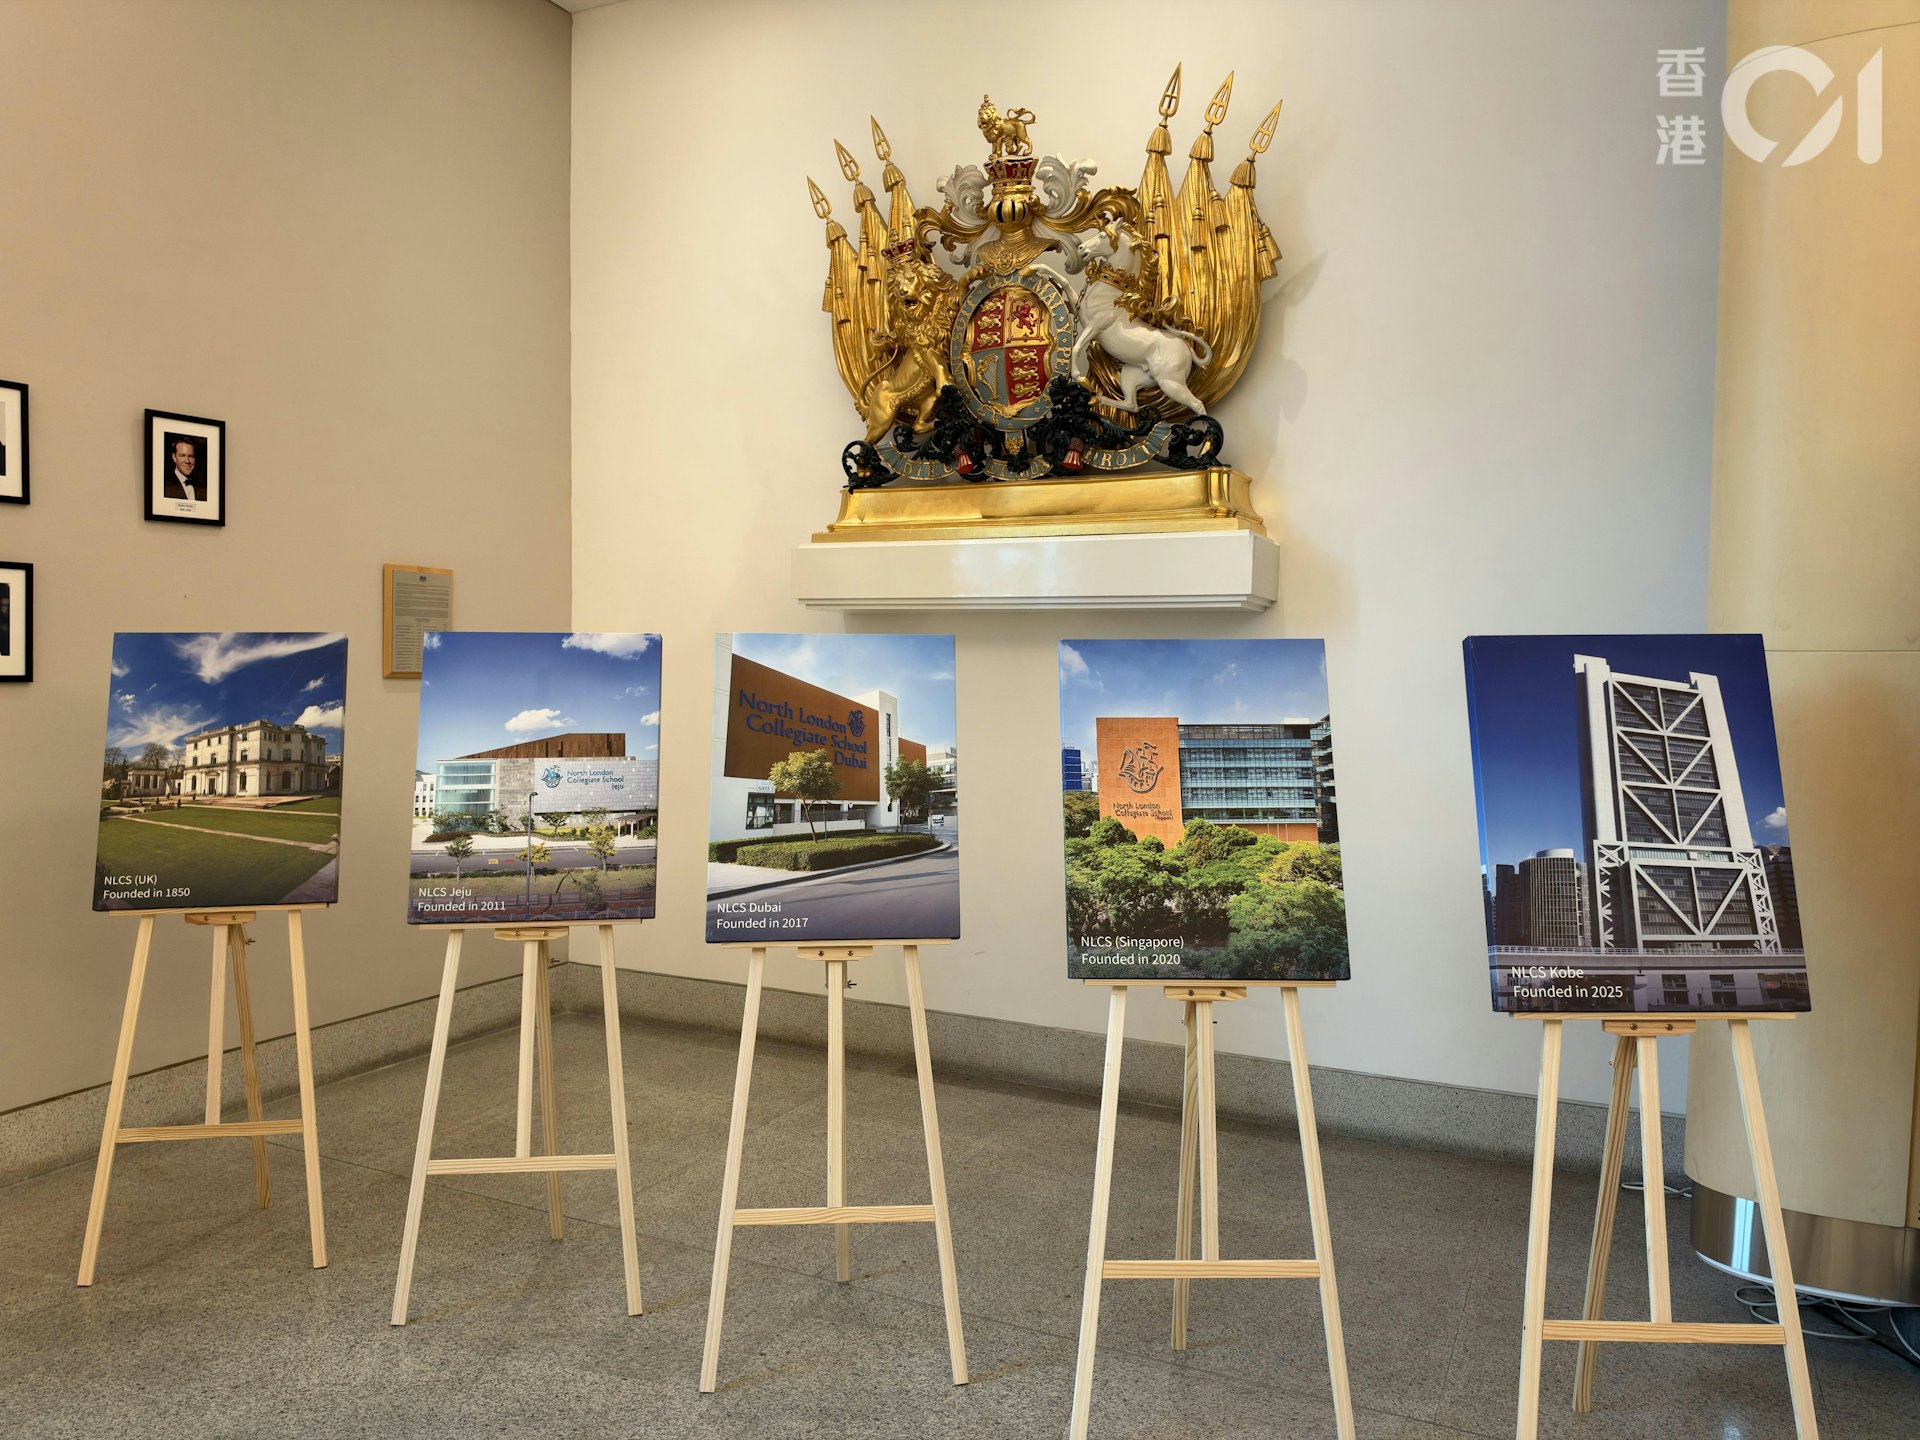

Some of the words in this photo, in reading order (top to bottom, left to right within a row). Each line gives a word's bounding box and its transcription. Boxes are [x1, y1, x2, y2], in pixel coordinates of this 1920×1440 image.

[1032, 277, 1066, 317] MAL
[1084, 442, 1152, 467] DROIT
[739, 688, 793, 720] North
[799, 707, 847, 734] London
[746, 713, 827, 747] Collegiate
[831, 734, 867, 754] School
[834, 750, 867, 769] Dubai
[567, 776, 600, 785] Collegiate
[611, 783, 624, 791] Jeju
[104, 875, 132, 885] NLCS
[135, 874, 157, 886] (UK)
[103, 888, 150, 899] Founded
[153, 888, 162, 898] in
[165, 887, 191, 898] 1850
[418, 887, 447, 897] NLCS
[449, 887, 472, 899] Jeju
[418, 901, 465, 911] Founded
[468, 901, 478, 911] in
[480, 901, 506, 911] 2011
[717, 902, 746, 913] NLCS
[749, 902, 781, 913] Dubai
[716, 918, 766, 929] Founded
[769, 918, 779, 928] in
[782, 918, 809, 928] 2017
[1081, 936, 1112, 947] NLCS
[1115, 935, 1184, 950] (Singapore)
[1081, 953, 1135, 965] Founded
[1138, 953, 1149, 964] in
[1152, 953, 1181, 965] 2020
[1511, 966, 1546, 978] NLCS
[1550, 966, 1584, 979] Kobe
[1513, 985, 1572, 998] Founded
[1575, 985, 1588, 998] in
[1591, 985, 1624, 998] 2025
